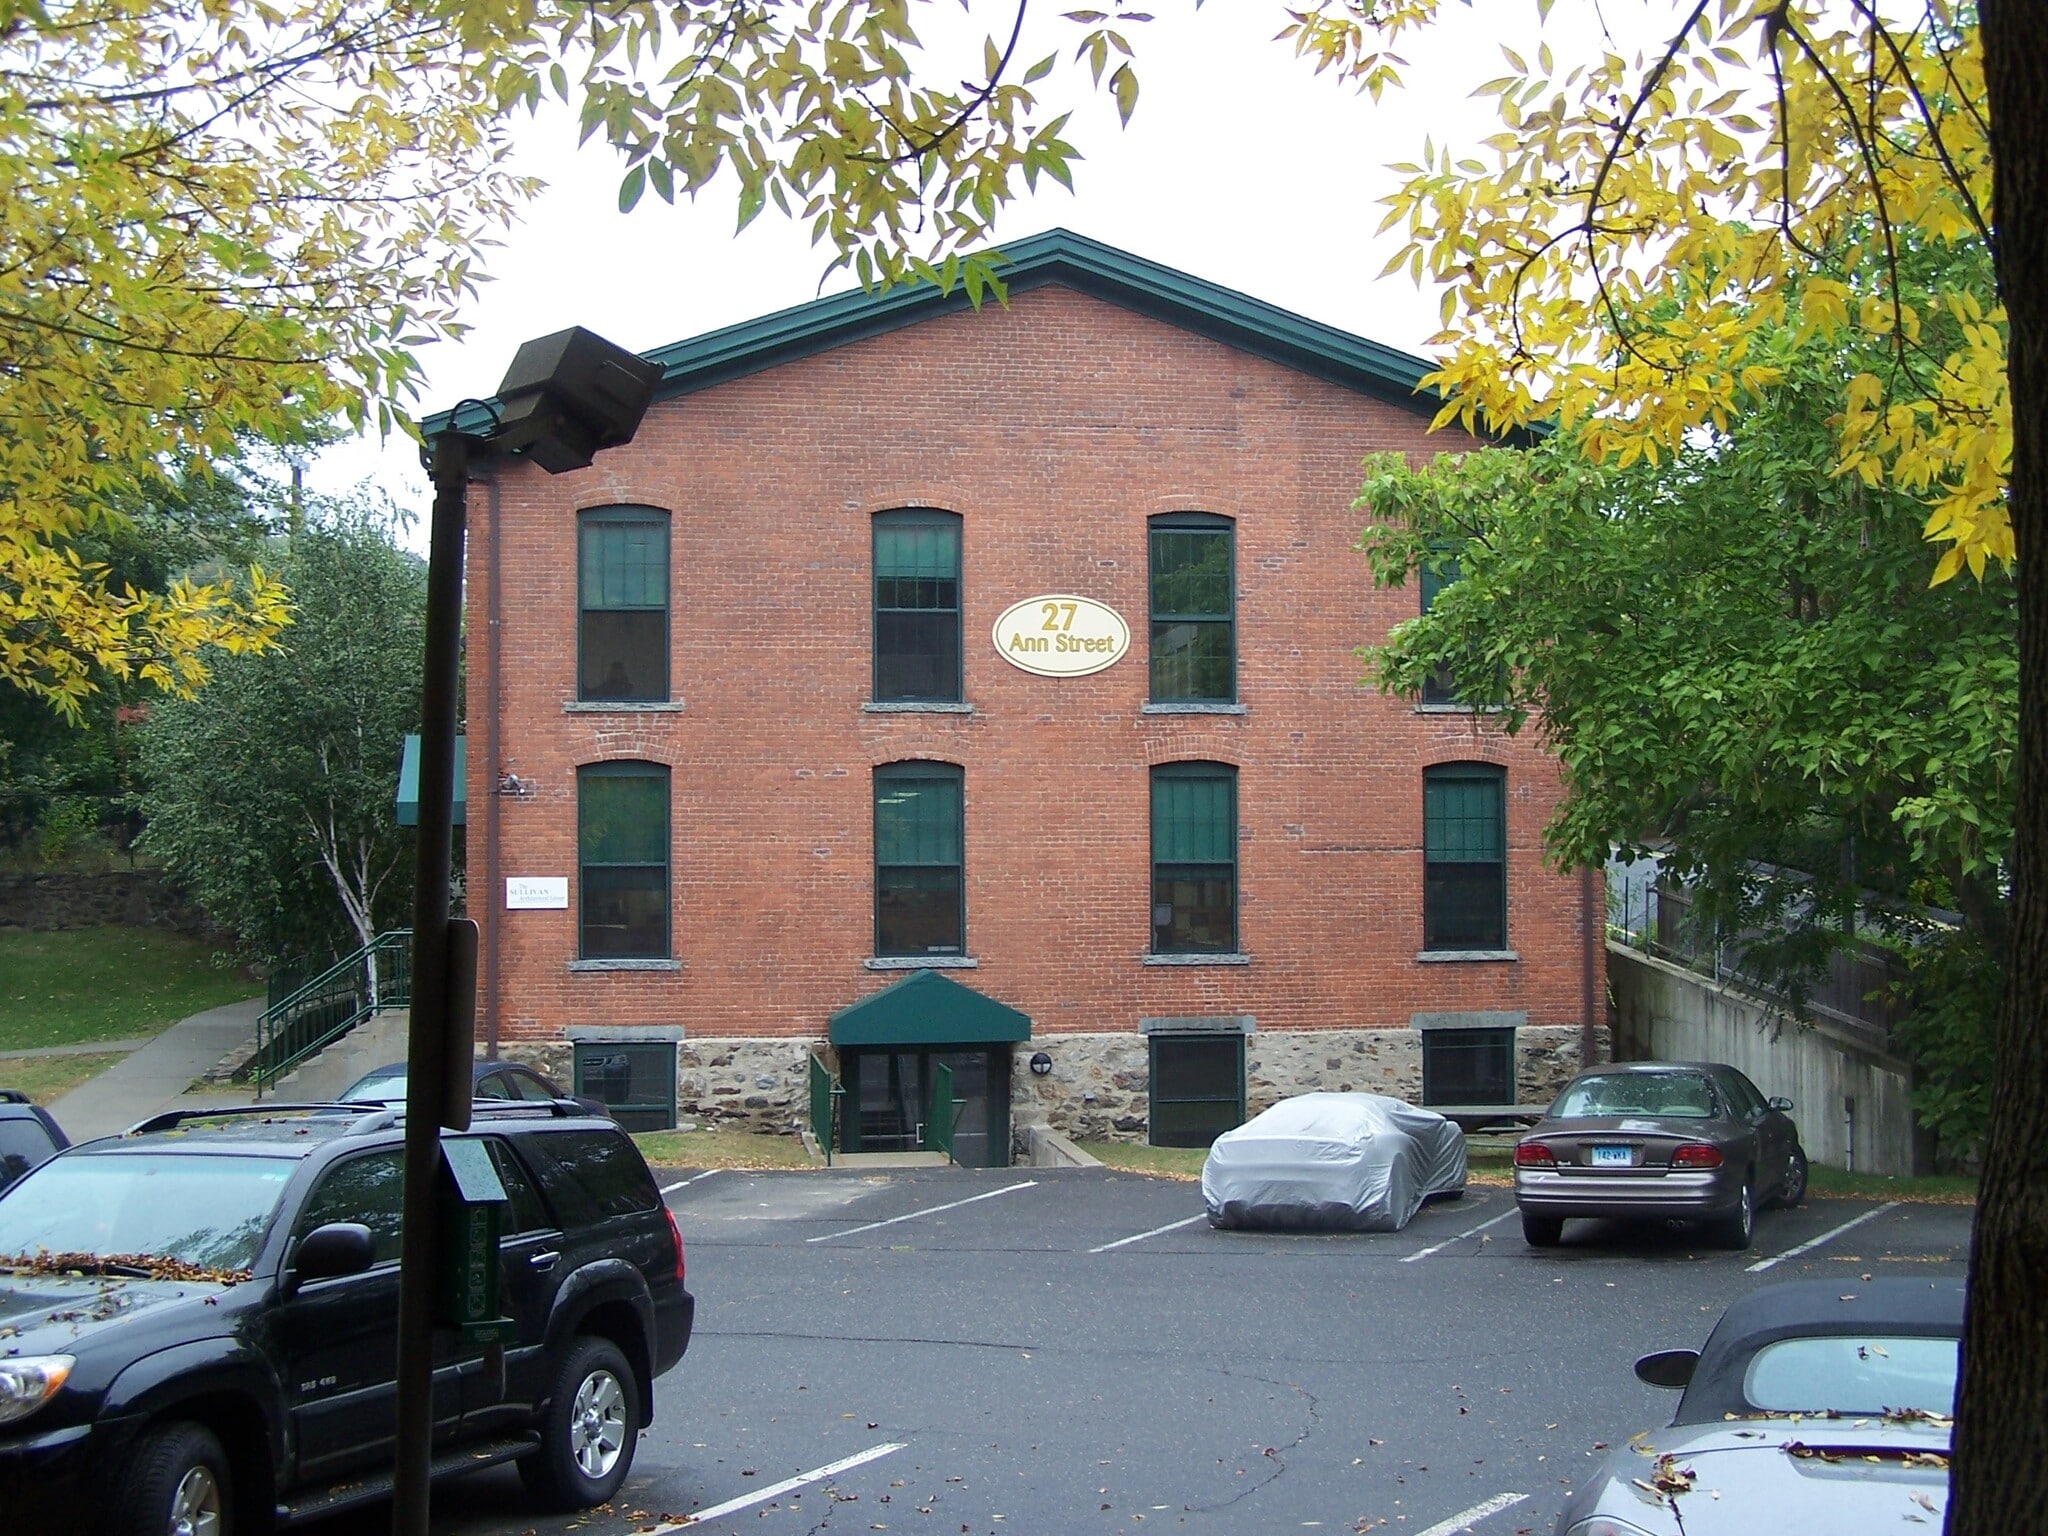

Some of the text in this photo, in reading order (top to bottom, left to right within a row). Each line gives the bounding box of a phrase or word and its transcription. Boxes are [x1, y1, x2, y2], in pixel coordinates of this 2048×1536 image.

[1041, 602, 1078, 631] 27
[1009, 632, 1115, 653] Ann Street
[509, 888, 549, 896] SULLIVAN
